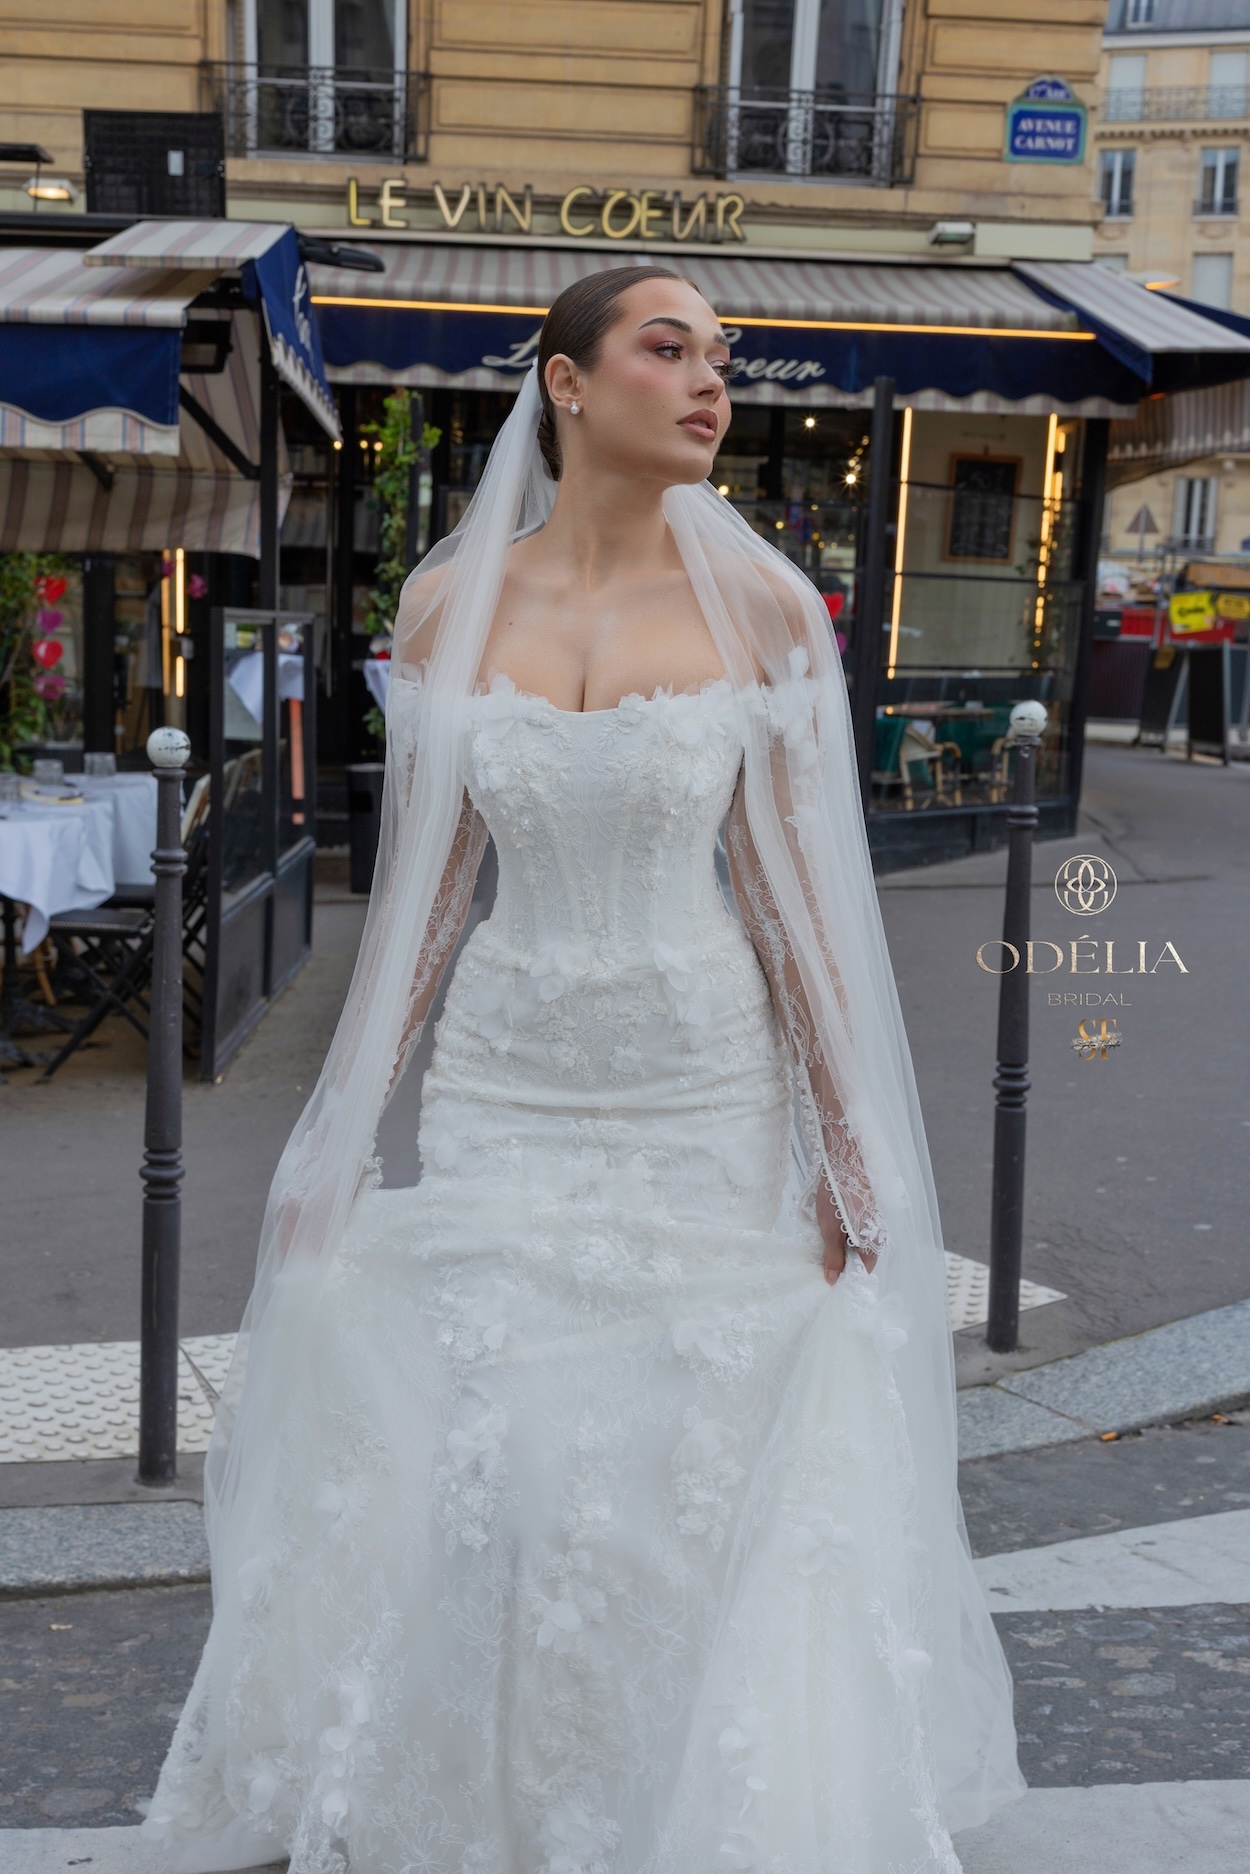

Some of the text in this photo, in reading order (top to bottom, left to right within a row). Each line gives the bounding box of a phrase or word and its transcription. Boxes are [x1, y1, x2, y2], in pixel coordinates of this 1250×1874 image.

[1017, 118, 1077, 134] AVENUE
[1014, 134, 1076, 152] CARNOT
[347, 177, 408, 228] LE
[433, 181, 533, 234] VIN
